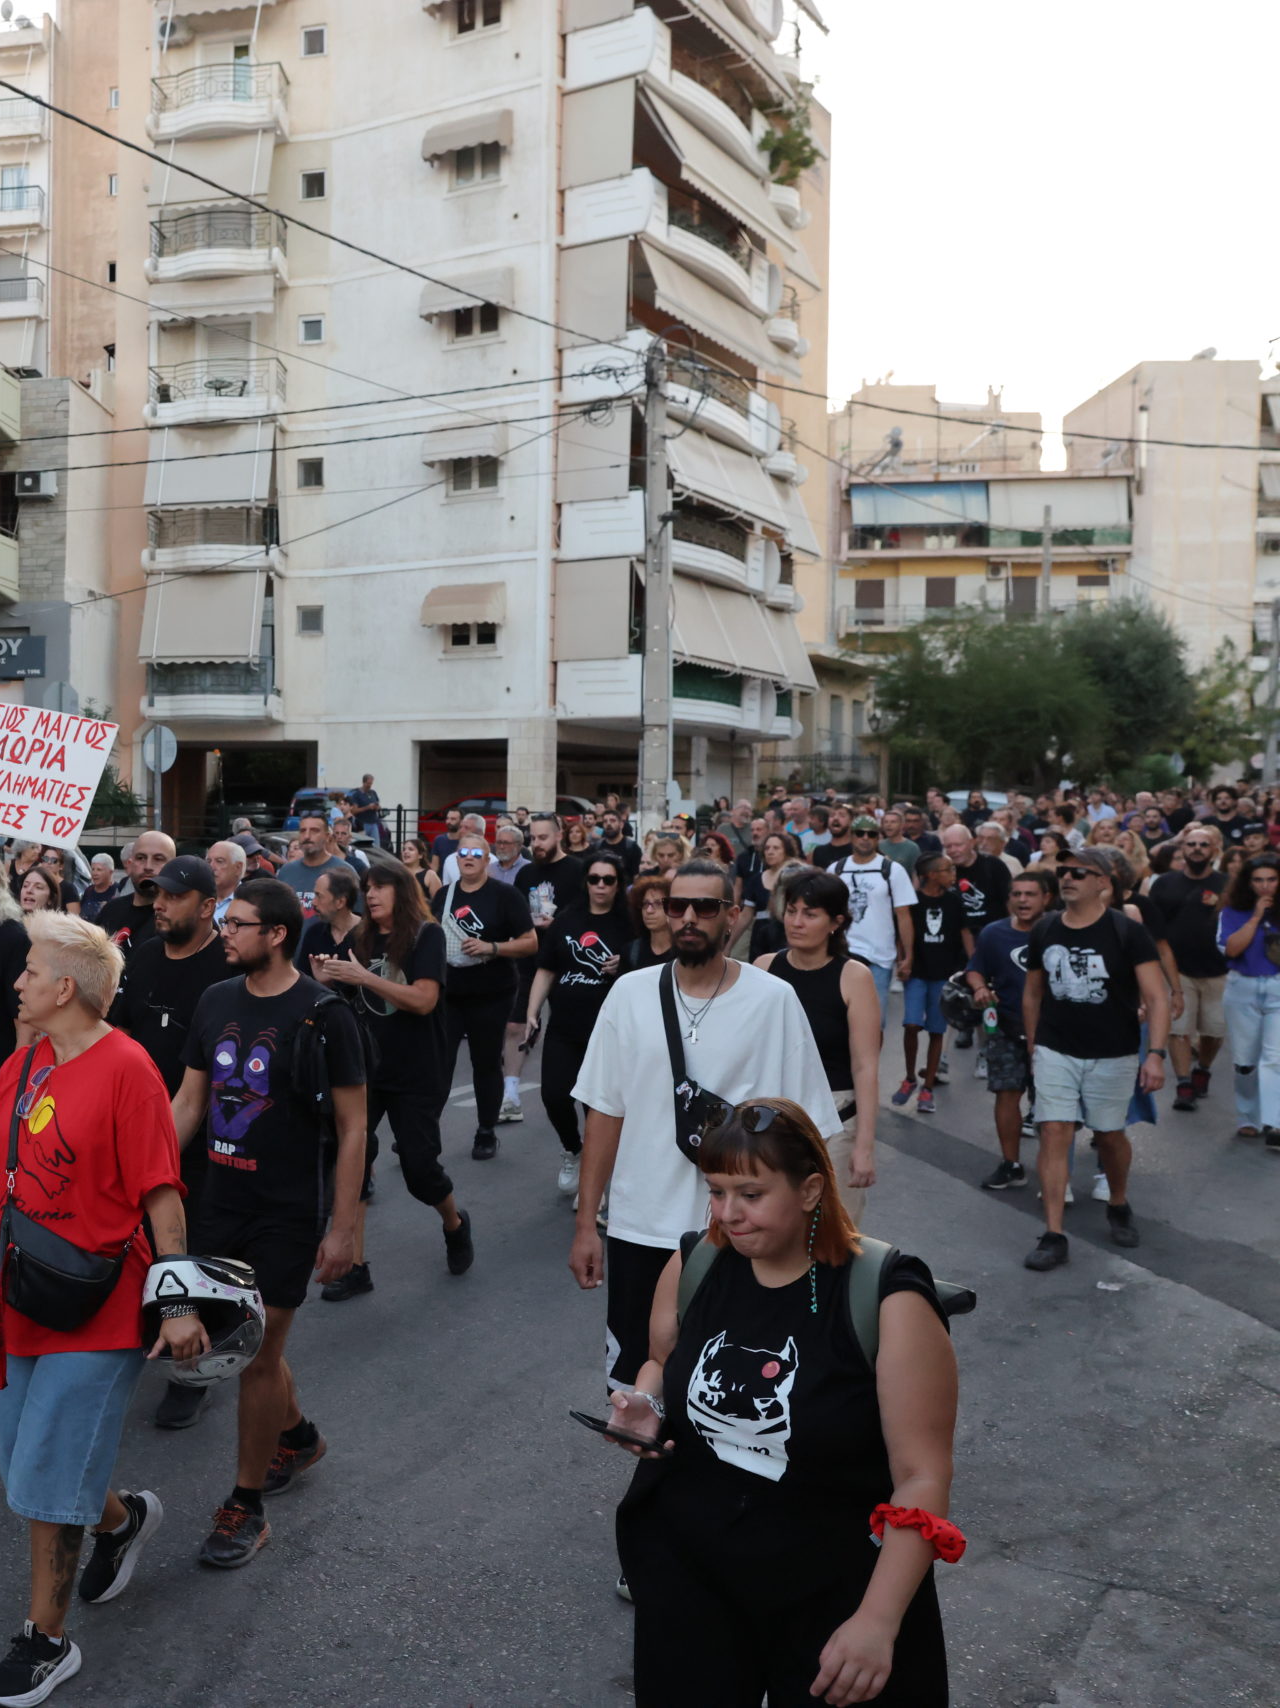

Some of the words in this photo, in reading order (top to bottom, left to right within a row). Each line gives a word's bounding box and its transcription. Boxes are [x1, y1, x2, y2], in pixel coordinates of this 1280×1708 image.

[32, 711, 117, 750] ΜΑΓΓΟΣ
[40, 810, 81, 838] ΤΟΥ
[214, 1139, 236, 1155] RAP
